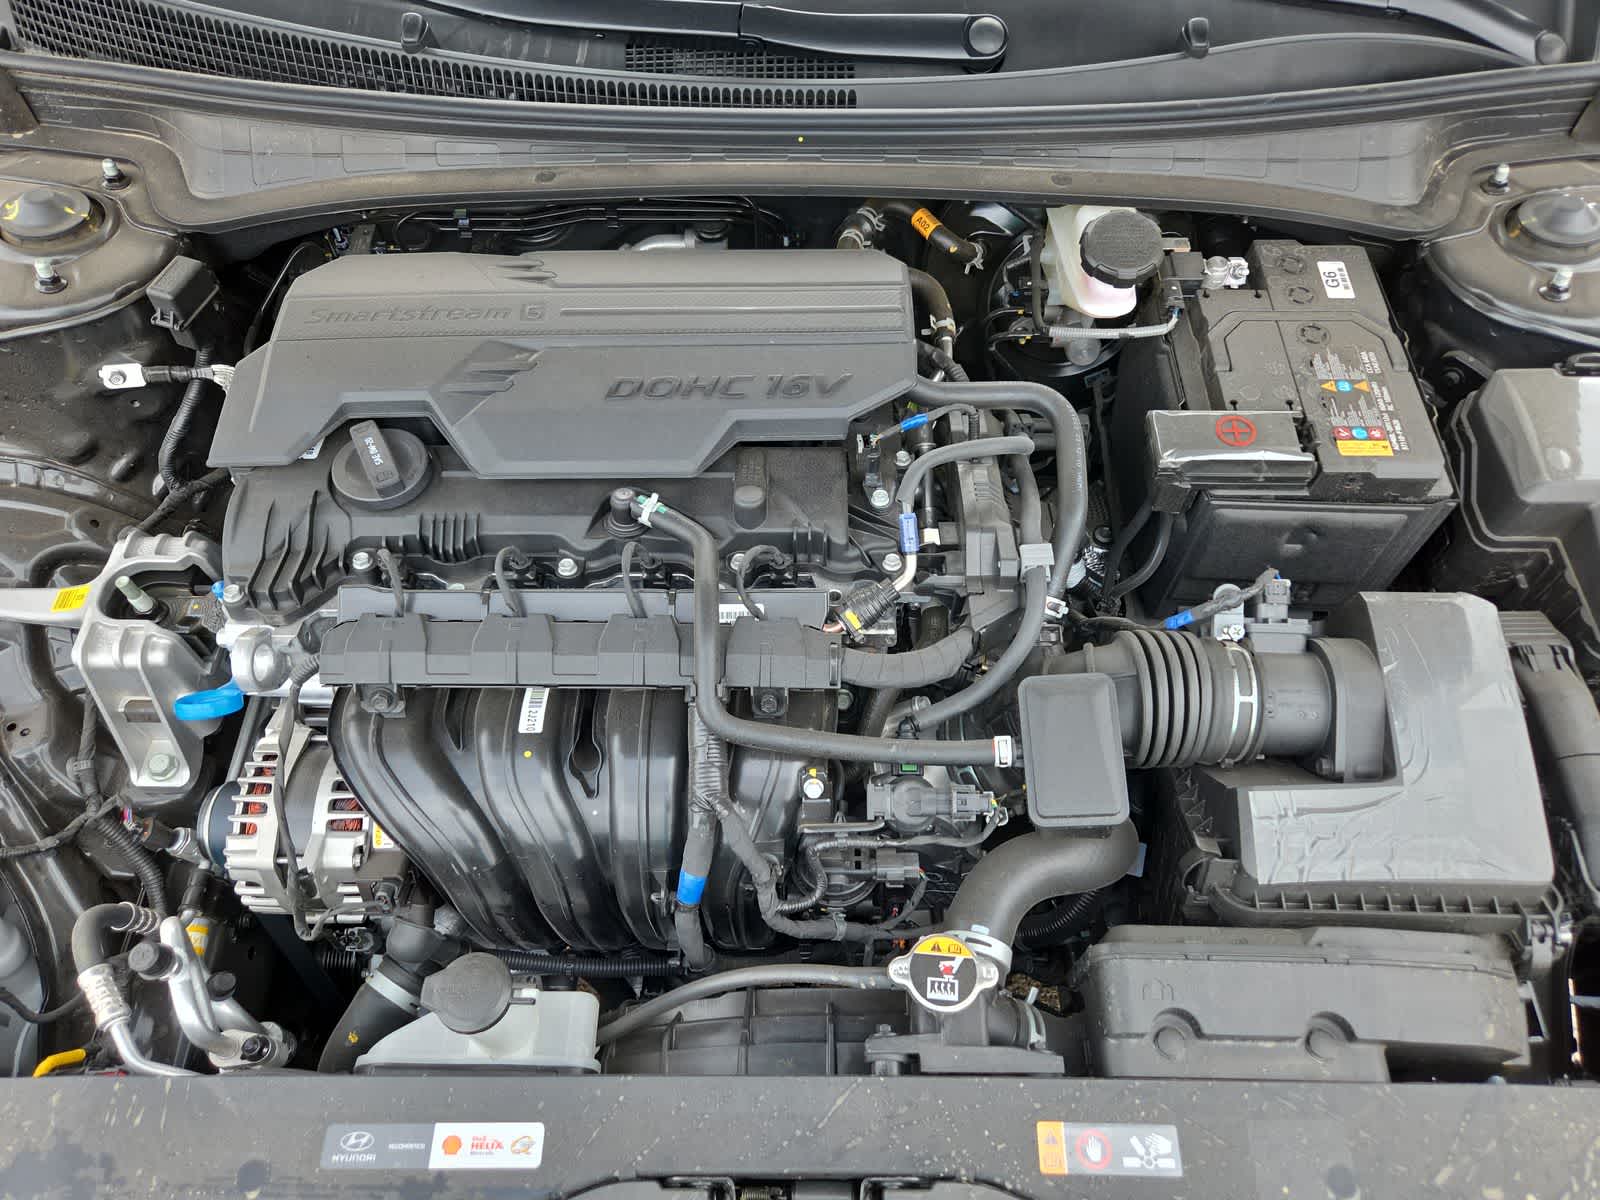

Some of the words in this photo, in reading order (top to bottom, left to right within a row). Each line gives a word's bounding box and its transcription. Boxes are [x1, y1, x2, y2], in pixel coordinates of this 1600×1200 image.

[916, 216, 930, 232] A02
[1323, 271, 1340, 288] G6
[304, 303, 512, 325] Smartstream
[605, 374, 755, 400] DOHC
[766, 373, 853, 400] 16V
[471, 1140, 503, 1150] HELIX
[331, 1153, 377, 1163] HYUNDAI
